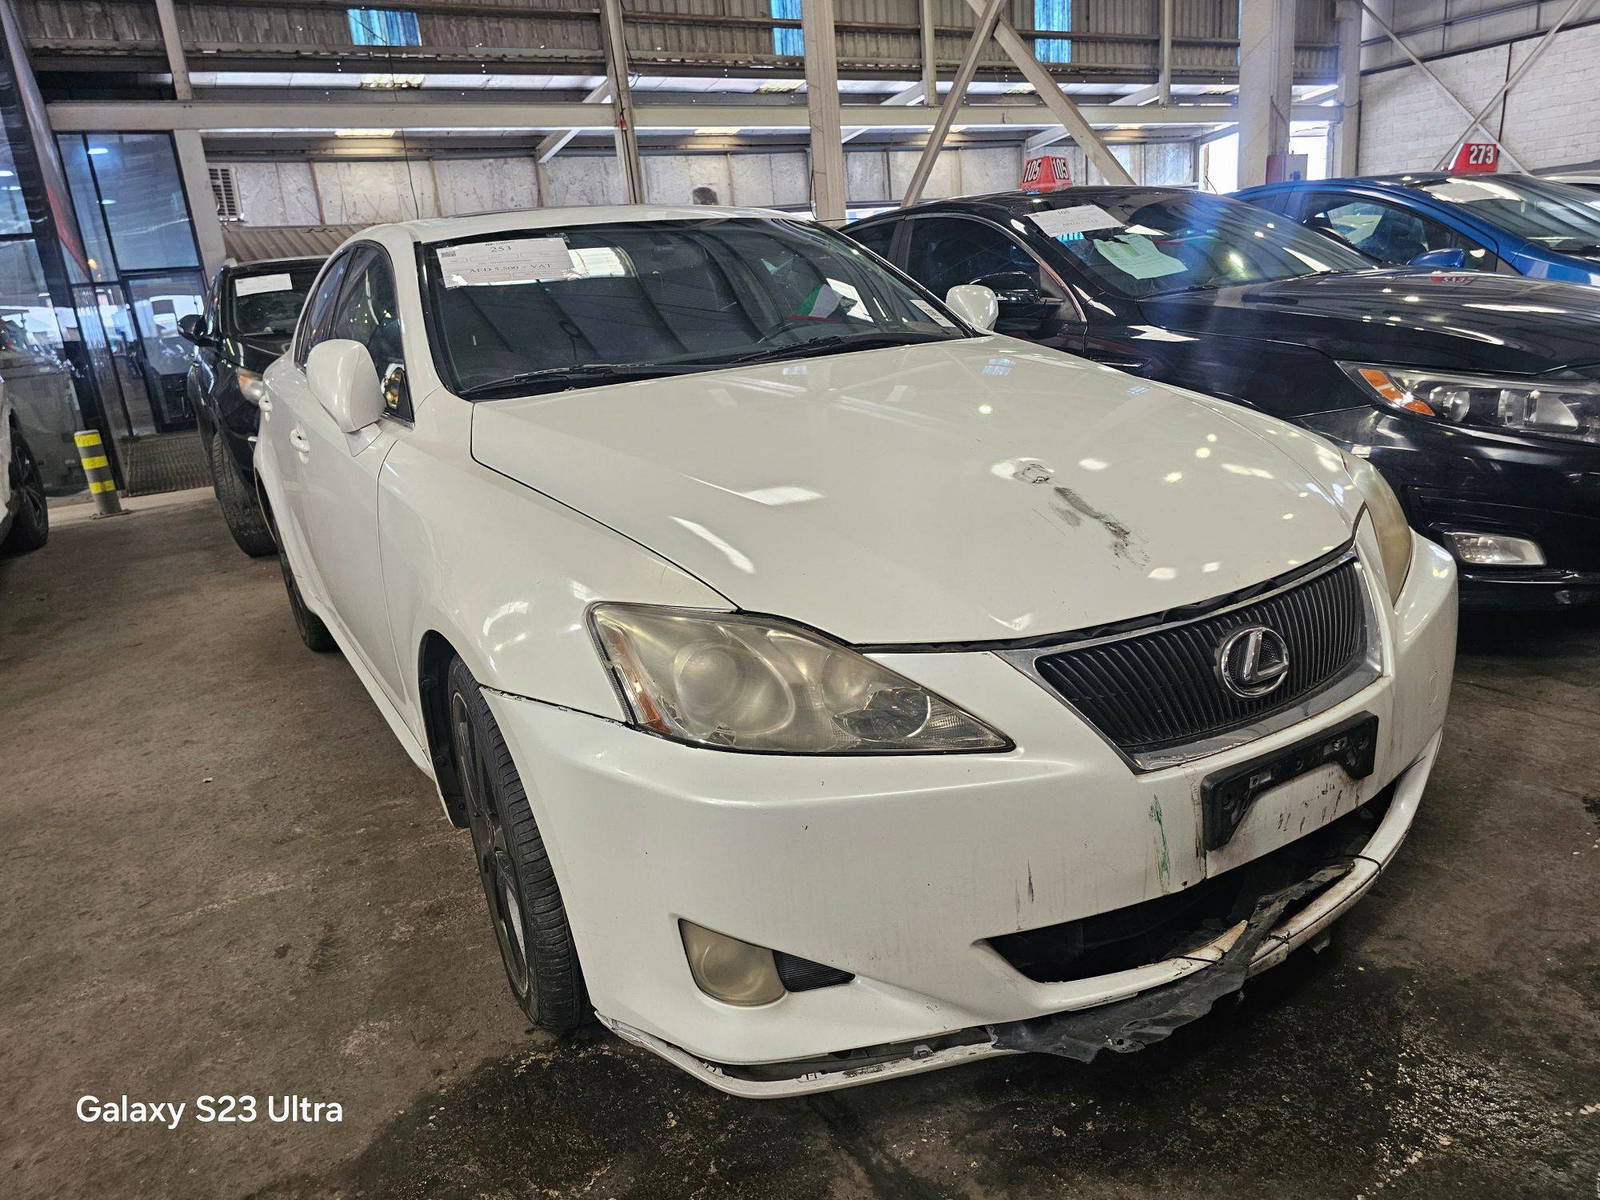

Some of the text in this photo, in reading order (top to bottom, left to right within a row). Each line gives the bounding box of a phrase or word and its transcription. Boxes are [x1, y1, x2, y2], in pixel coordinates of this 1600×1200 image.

[1469, 144, 1494, 165] 273
[1024, 159, 1042, 182] 105
[1053, 158, 1069, 180] 105
